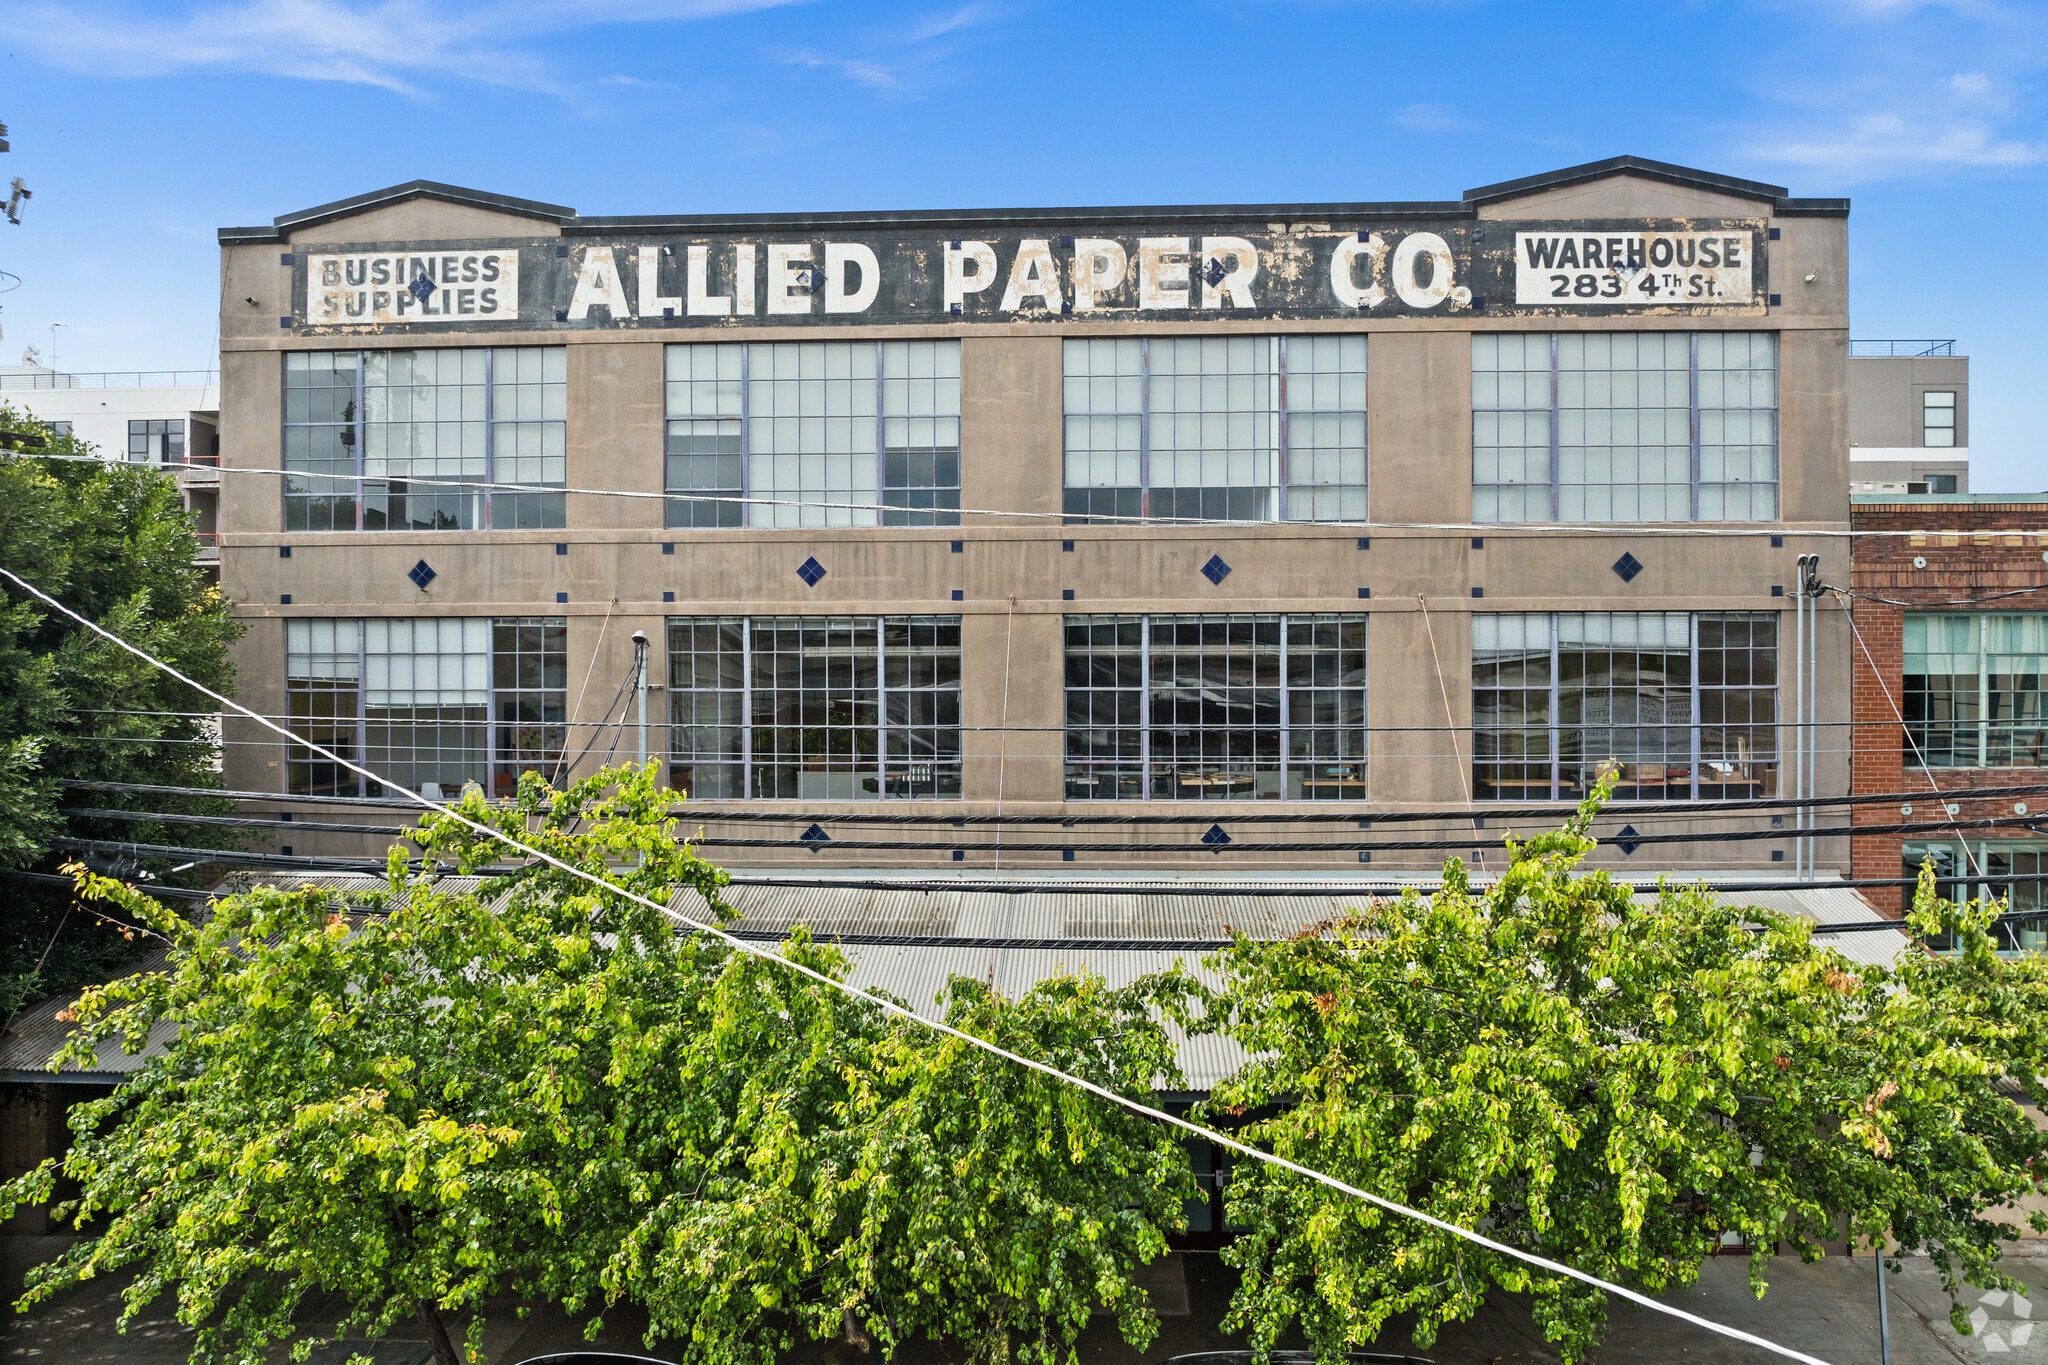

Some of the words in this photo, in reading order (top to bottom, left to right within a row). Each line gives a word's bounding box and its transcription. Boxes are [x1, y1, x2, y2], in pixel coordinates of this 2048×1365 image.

[1524, 237, 1742, 269] WAREHOUSE
[322, 255, 501, 286] BUSINESS
[567, 242, 881, 319] ALLIED
[943, 235, 1259, 312] PAPER
[1331, 231, 1473, 311] CO.
[1550, 274, 1622, 298] 283
[1688, 274, 1723, 298] St.
[322, 287, 499, 317] SUPPLIES
